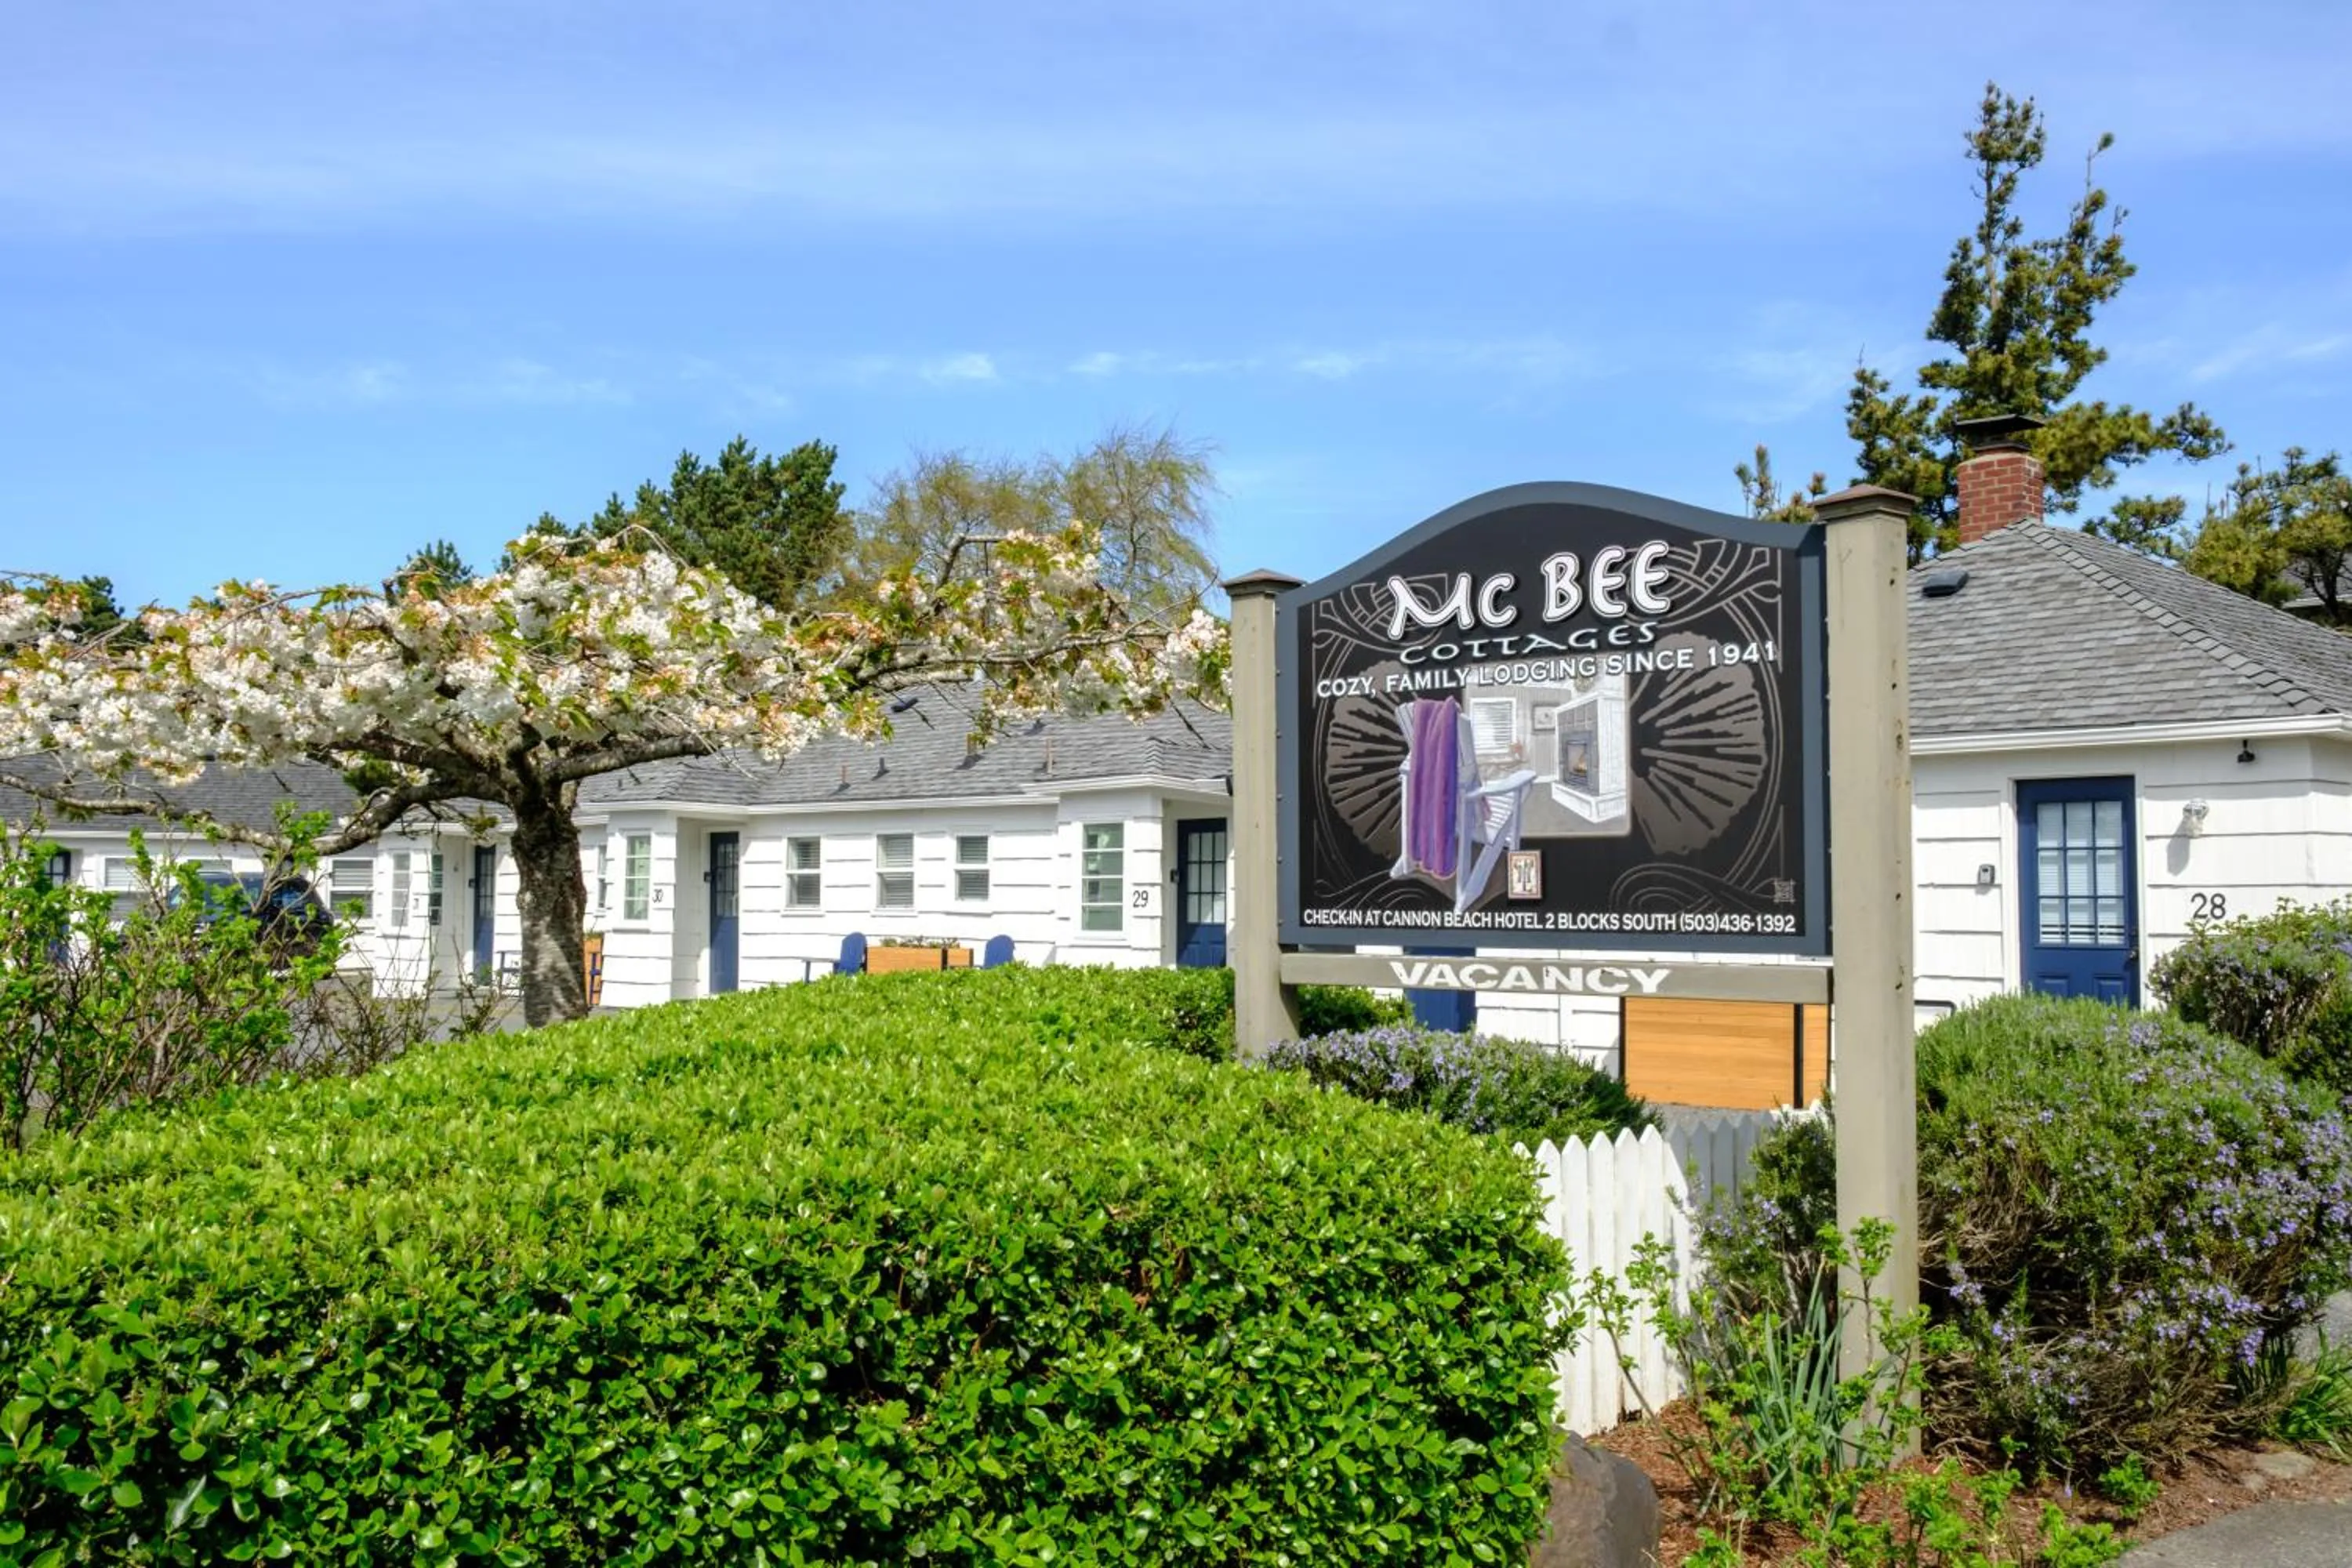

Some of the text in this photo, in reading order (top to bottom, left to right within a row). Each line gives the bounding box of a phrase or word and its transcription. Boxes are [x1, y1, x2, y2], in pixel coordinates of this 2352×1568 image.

[1541, 539, 1671, 622] BEE
[1399, 622, 1658, 664] COTTAGES
[1316, 641, 1777, 698] COZY, FAMILY LODGING SINCE 1941
[1133, 890, 1149, 908] 29
[2190, 893, 2226, 920] 28
[1304, 909, 1796, 932] CHECK-IN AT CANNON BEACH HOTEL 2 BLOCKS SOUTH (503)436-1392
[1389, 961, 1671, 994] VACANCY
